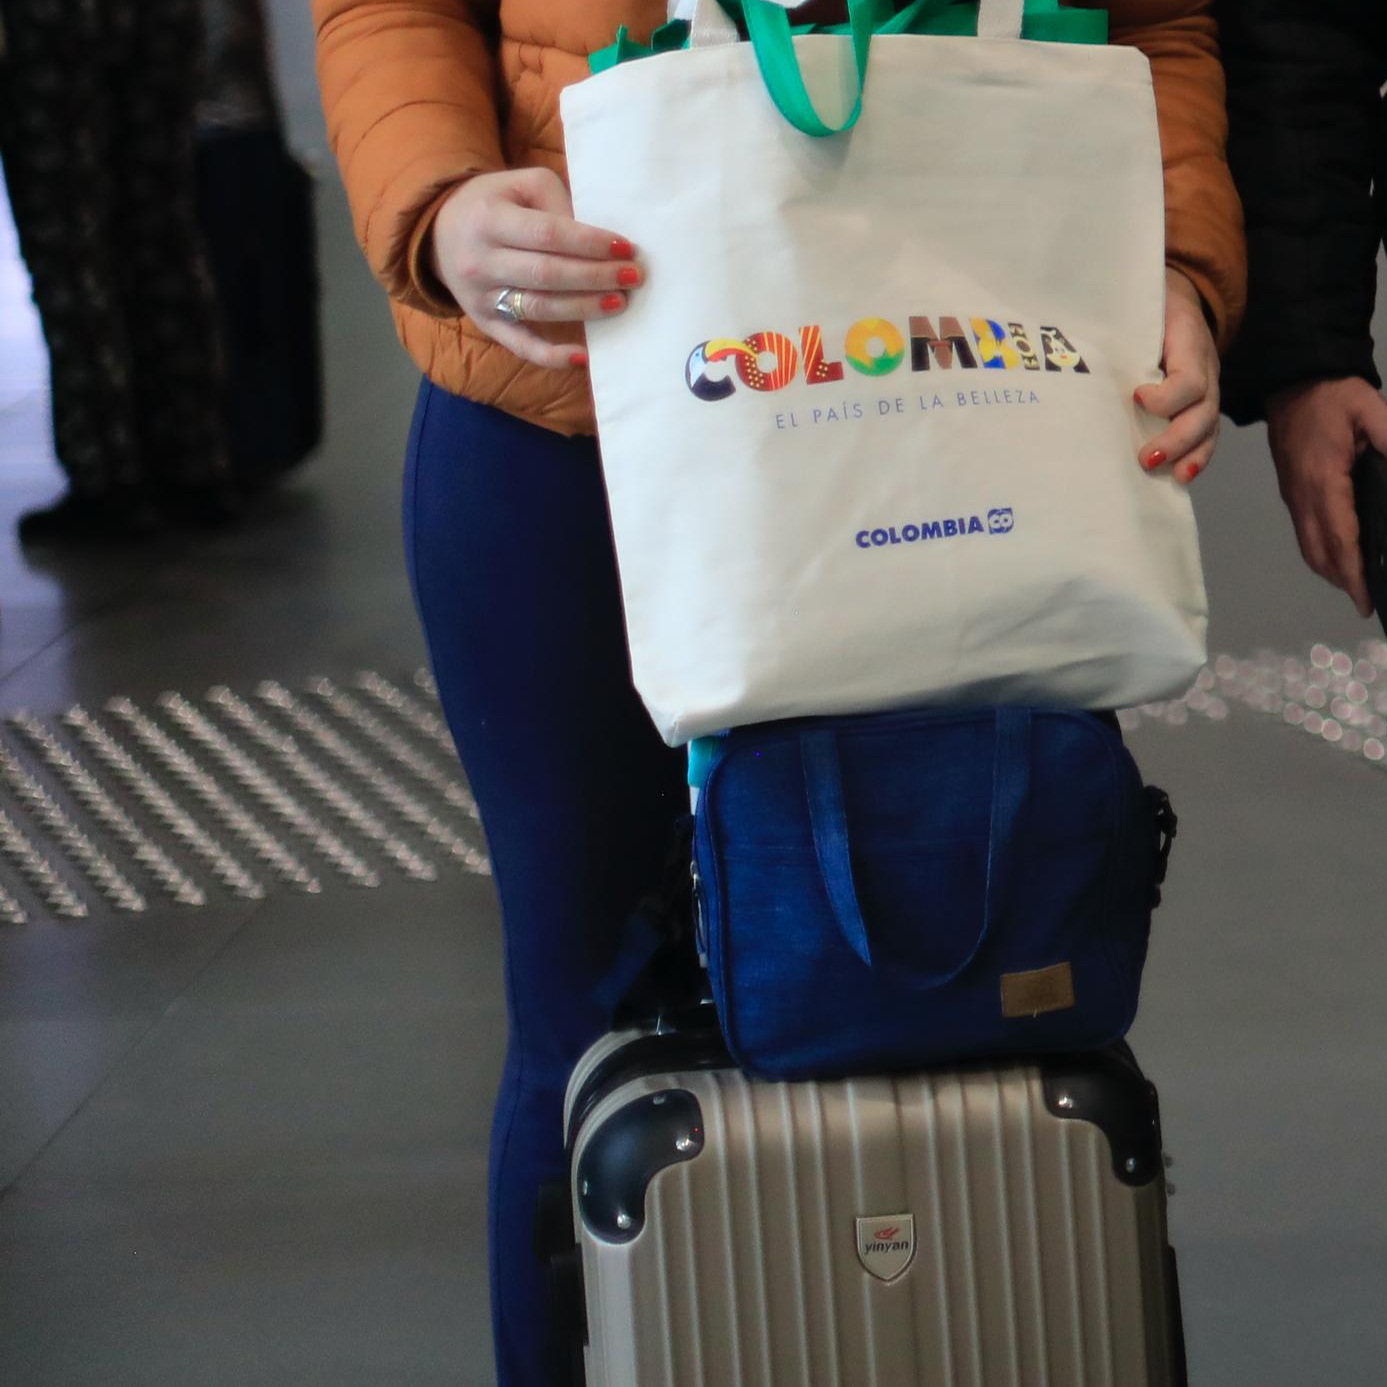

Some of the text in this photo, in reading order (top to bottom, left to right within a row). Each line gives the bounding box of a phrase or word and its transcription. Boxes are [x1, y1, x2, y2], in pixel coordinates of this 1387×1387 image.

[685, 316, 1090, 401] COLOMBIA
[775, 389, 1040, 429] EL PAÍS DE LA BELLEZA
[855, 516, 984, 548] COLOMBIA
[864, 1239, 910, 1256] yinyan
